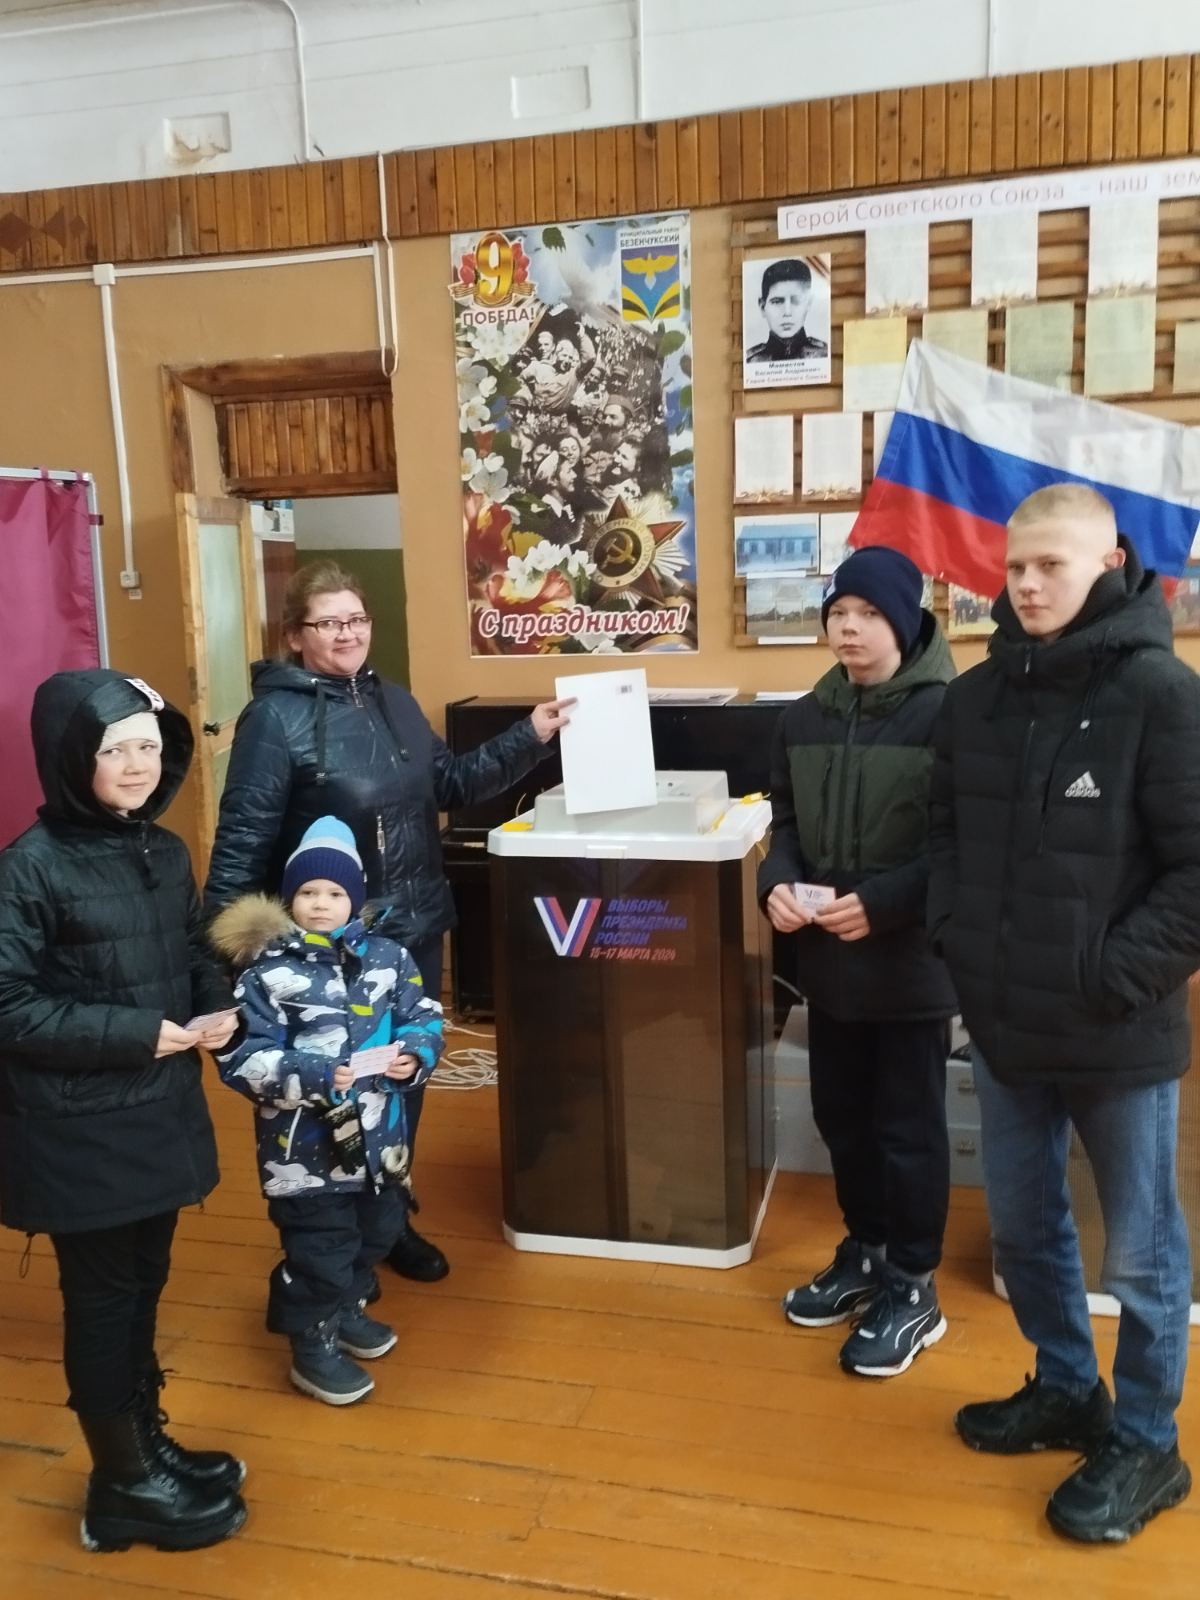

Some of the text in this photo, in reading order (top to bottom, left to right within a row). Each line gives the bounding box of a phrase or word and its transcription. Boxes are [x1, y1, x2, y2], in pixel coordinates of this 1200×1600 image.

[785, 203, 849, 230] Герой
[855, 193, 983, 221] Советского
[990, 184, 1065, 205] Союза
[1099, 174, 1148, 194] наш
[620, 233, 680, 247] БЕЗЕНЧУКСКИЙ
[476, 232, 515, 305] 9
[462, 309, 535, 327] ПОБЕДА!
[480, 603, 691, 644] С праздником!
[607, 899, 670, 913] ВЫБОРЫ
[594, 931, 651, 945] РОССИИ
[616, 948, 651, 961] МАРТА
[651, 948, 677, 961] 2024
